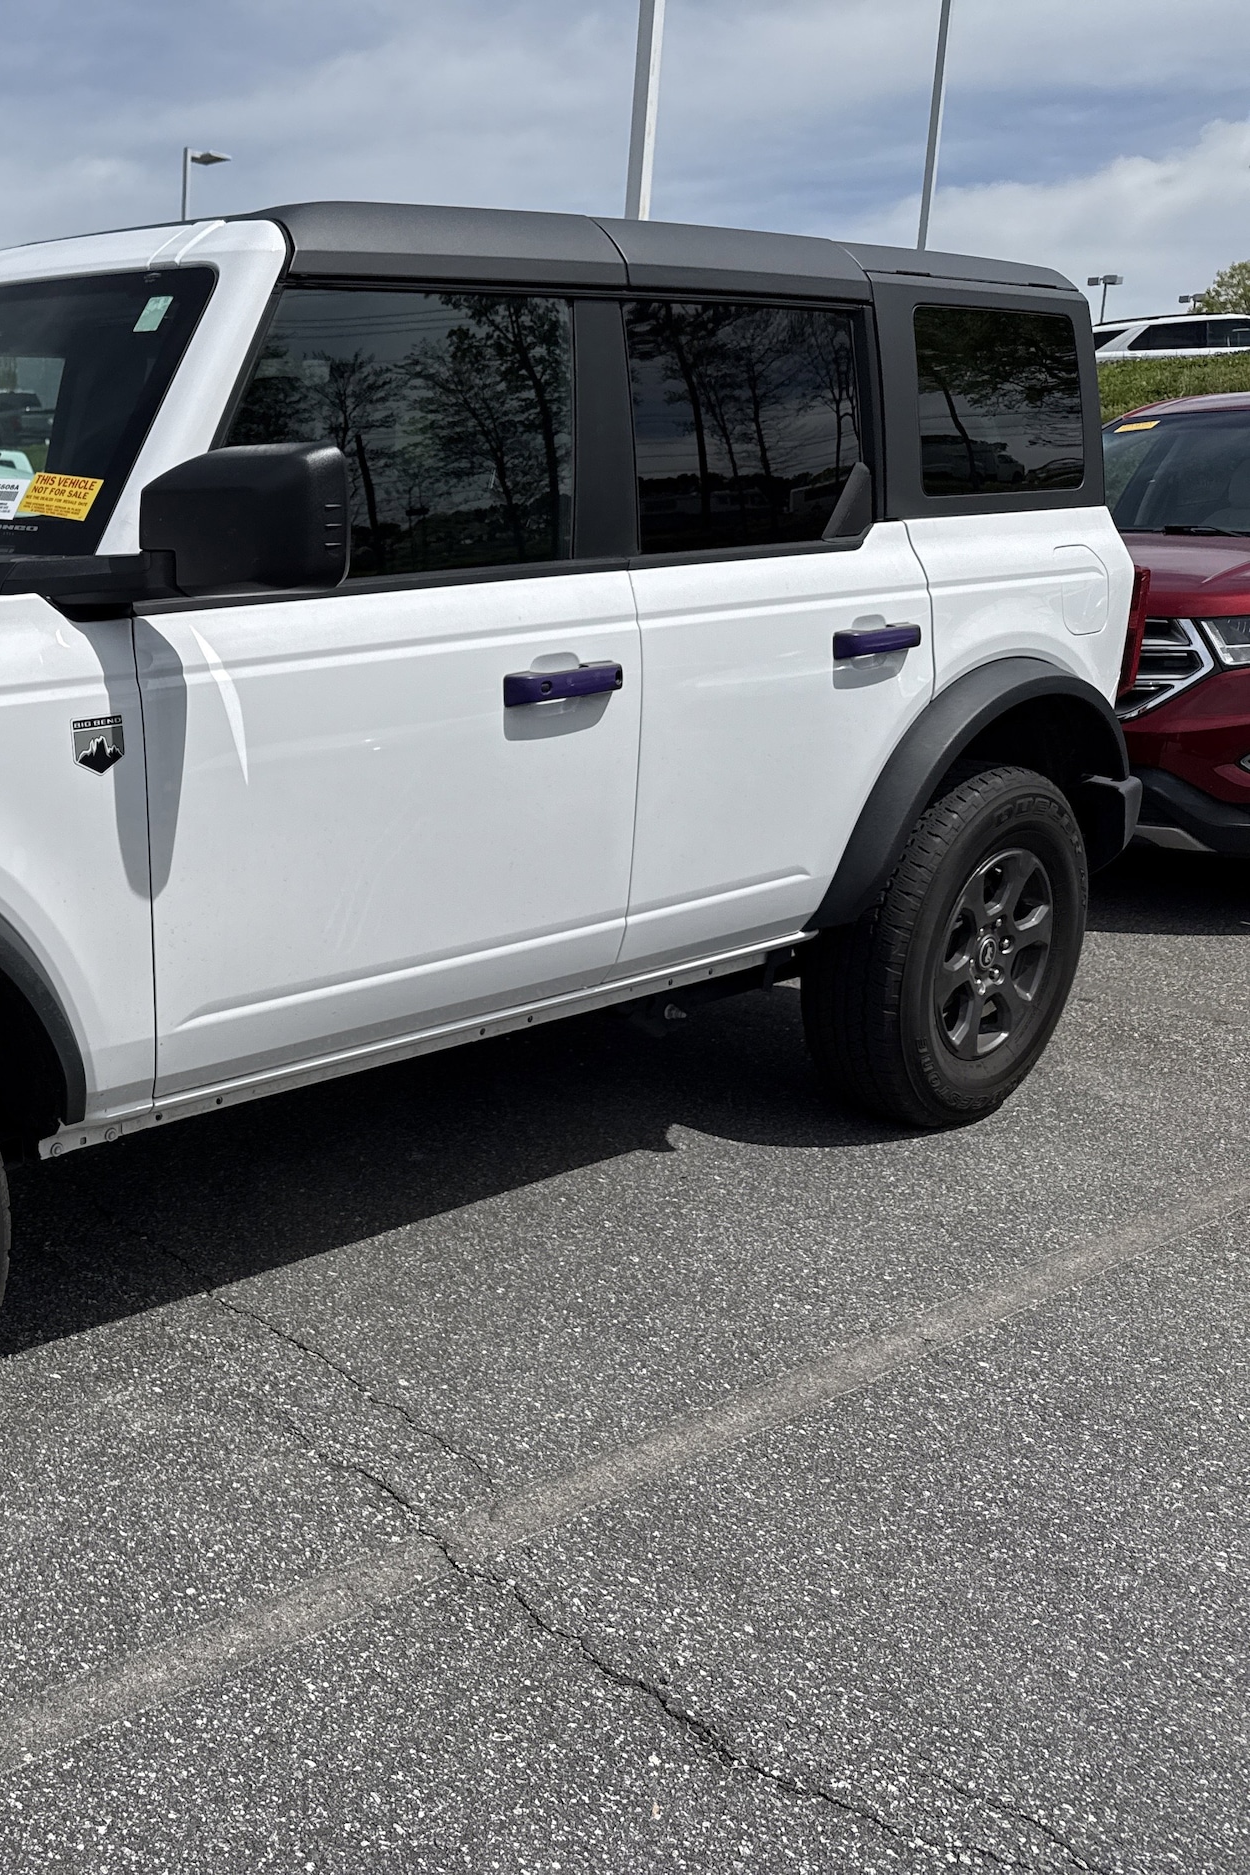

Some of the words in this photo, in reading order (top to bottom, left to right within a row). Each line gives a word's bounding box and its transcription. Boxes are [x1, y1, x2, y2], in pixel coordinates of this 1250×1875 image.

[36, 475, 56, 486] THIS
[58, 478, 97, 490] VEHICLE
[31, 485, 48, 494] NOT
[49, 487, 66, 497] FOR
[67, 489, 90, 500] SALE
[93, 717, 121, 726] BEND
